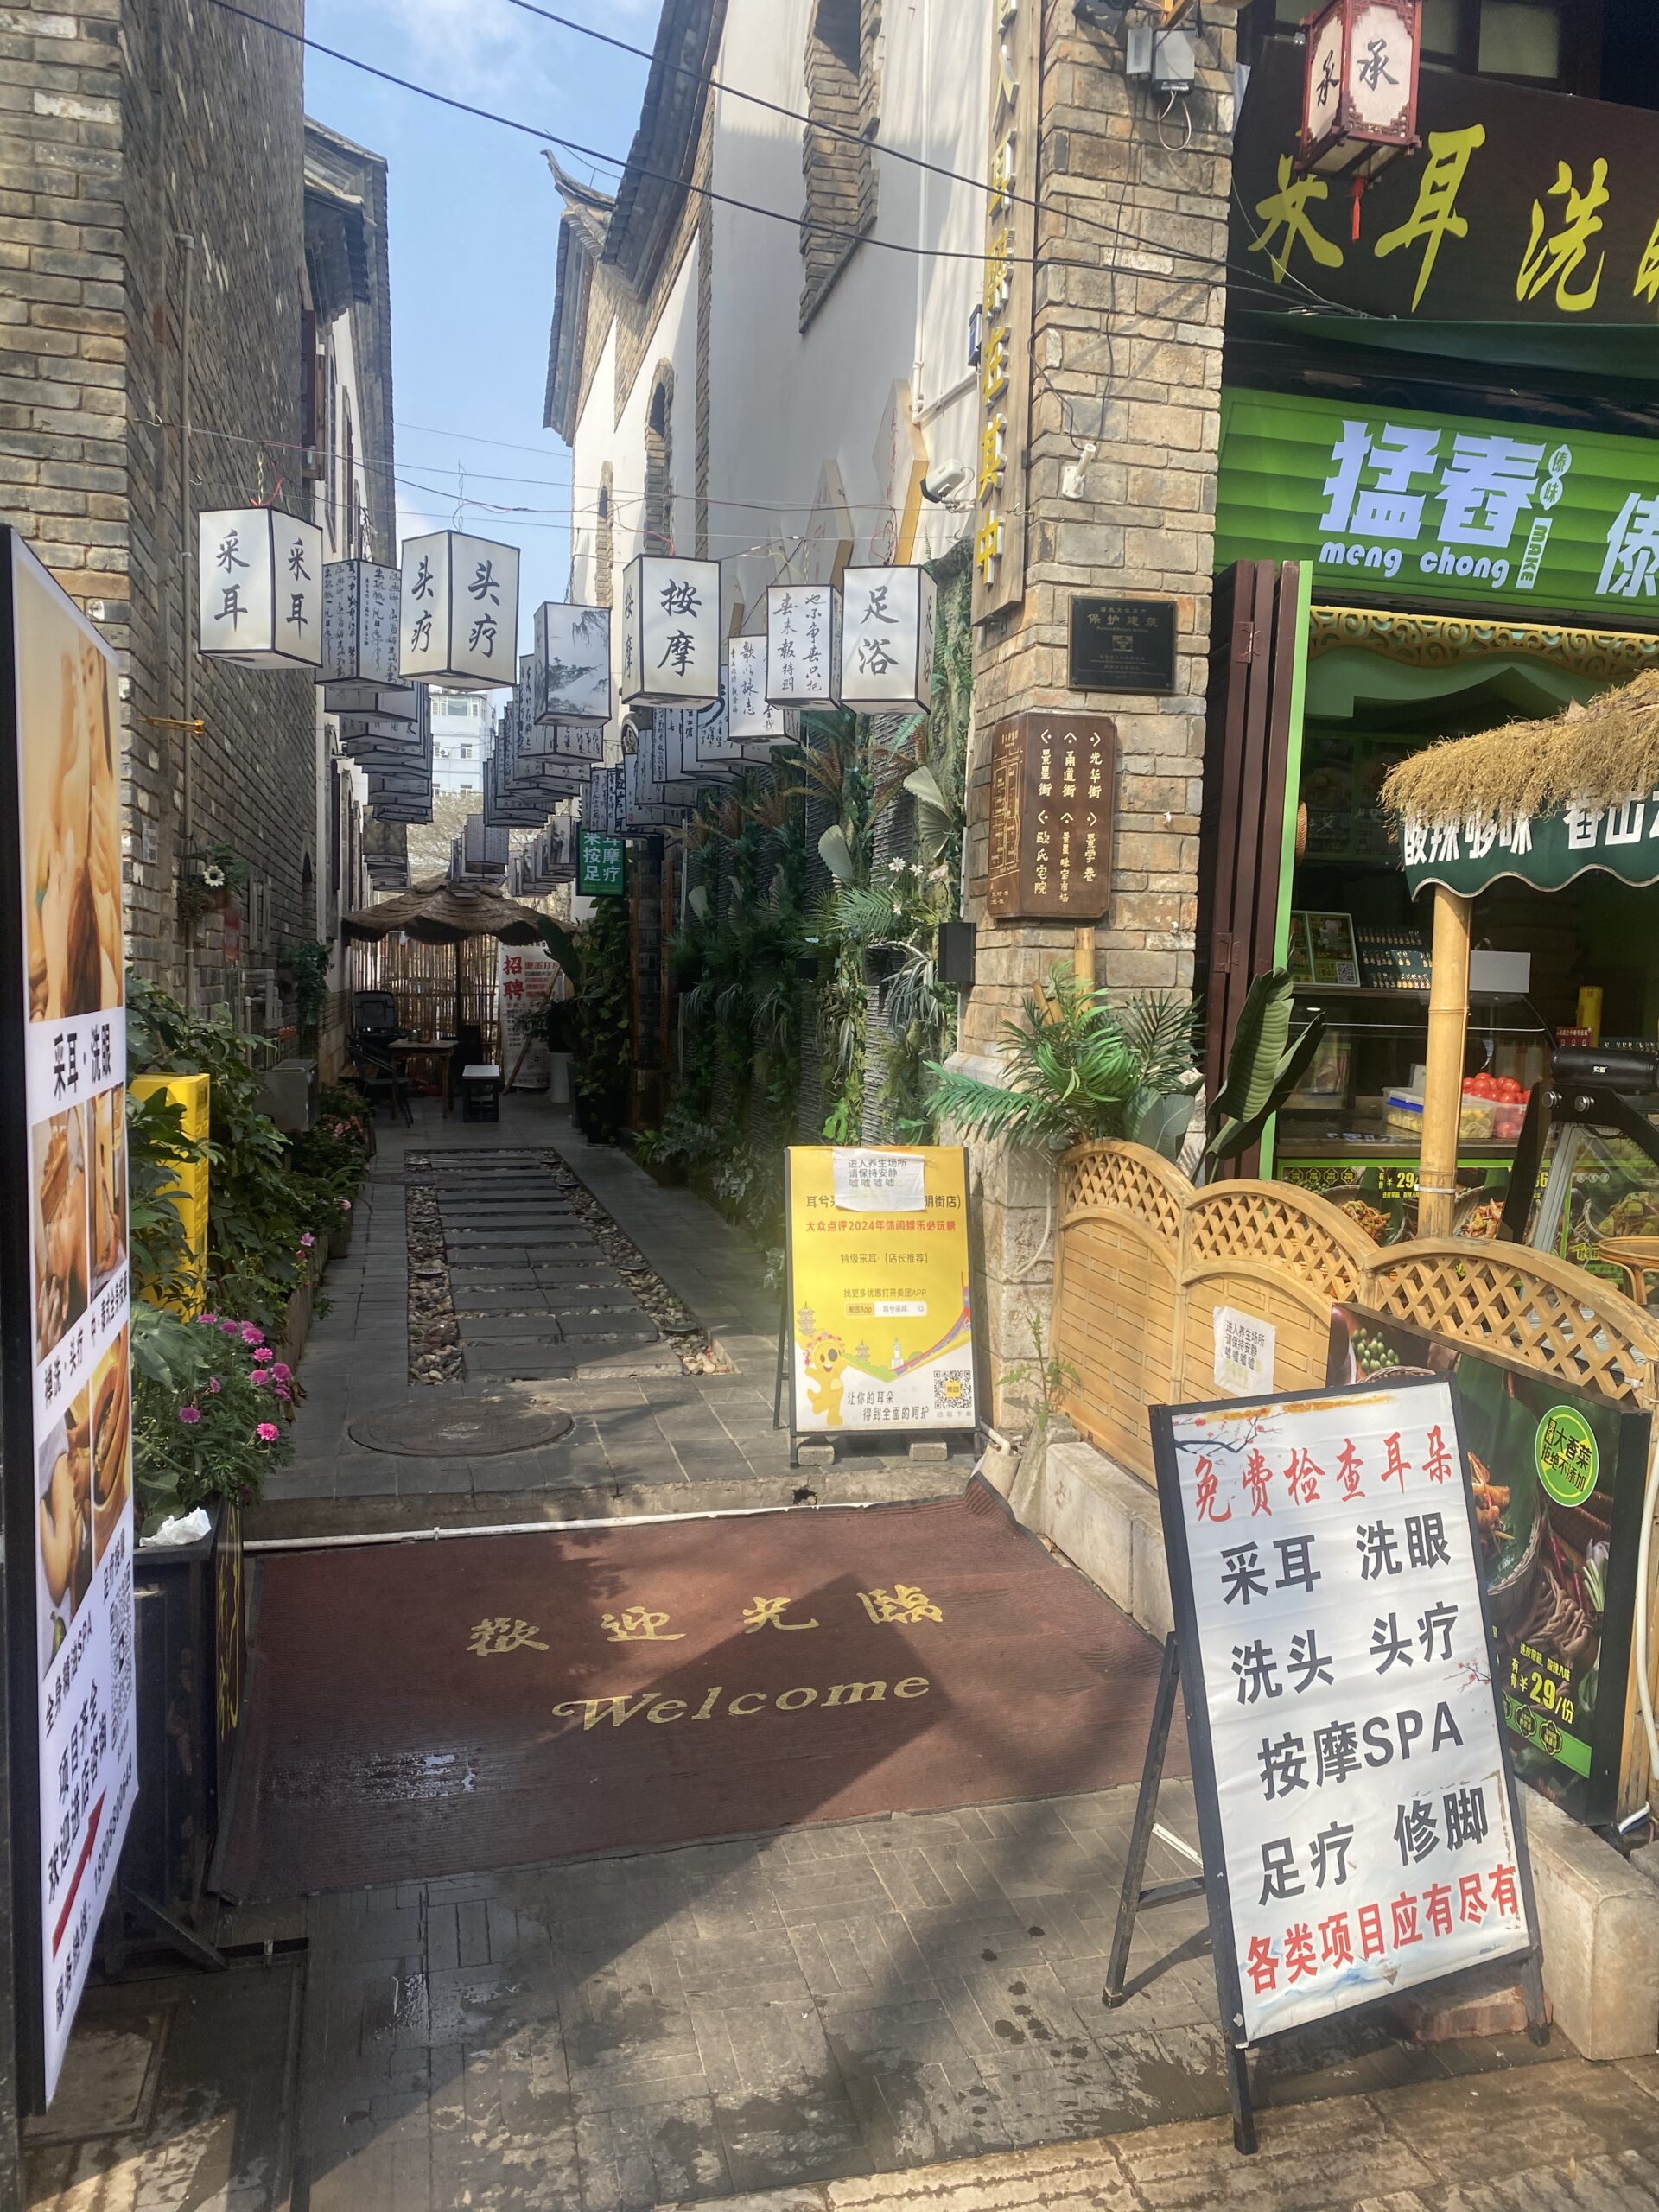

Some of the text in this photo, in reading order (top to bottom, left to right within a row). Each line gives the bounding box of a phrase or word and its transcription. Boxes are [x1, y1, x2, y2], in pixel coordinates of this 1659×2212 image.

[1248, 124, 1659, 312] 采耳洗
[214, 529, 250, 632] 采耳
[286, 537, 311, 639] 采耳
[1319, 541, 1510, 588] meng chong
[410, 555, 435, 653] 头疗
[467, 560, 500, 658] 头疗
[657, 578, 702, 677] 按摩
[858, 585, 899, 676] 足浴
[1062, 750, 1077, 798] 甬道街
[1087, 751, 1103, 799] 光华街
[583, 847, 620, 864] 按摩
[583, 865, 620, 882] 足疗
[1034, 831, 1051, 895] 欧氏宅院
[503, 955, 524, 1001] 招聘
[849, 1159, 907, 1168] 进入养生场所
[849, 1168, 898, 1179] 请保持安静
[1225, 1320, 1265, 1347] 进入养生场所
[847, 1391, 894, 1405] 让你的耳朵
[862, 1407, 929, 1421] 得到全面的呵护
[1195, 1425, 1453, 1522] 免费检查耳朵
[1553, 1427, 1592, 1471] 大香菜
[1220, 1511, 1452, 1606] 采耳 洗眼
[1231, 1600, 1460, 1706] 洗头 头疗
[551, 1675, 931, 1731] Welcome
[1257, 1700, 1464, 1801] 按摩SPA
[1259, 1787, 1488, 1906] 足疗 修脚
[1246, 1863, 1517, 1995] 各类项目应有尽有
